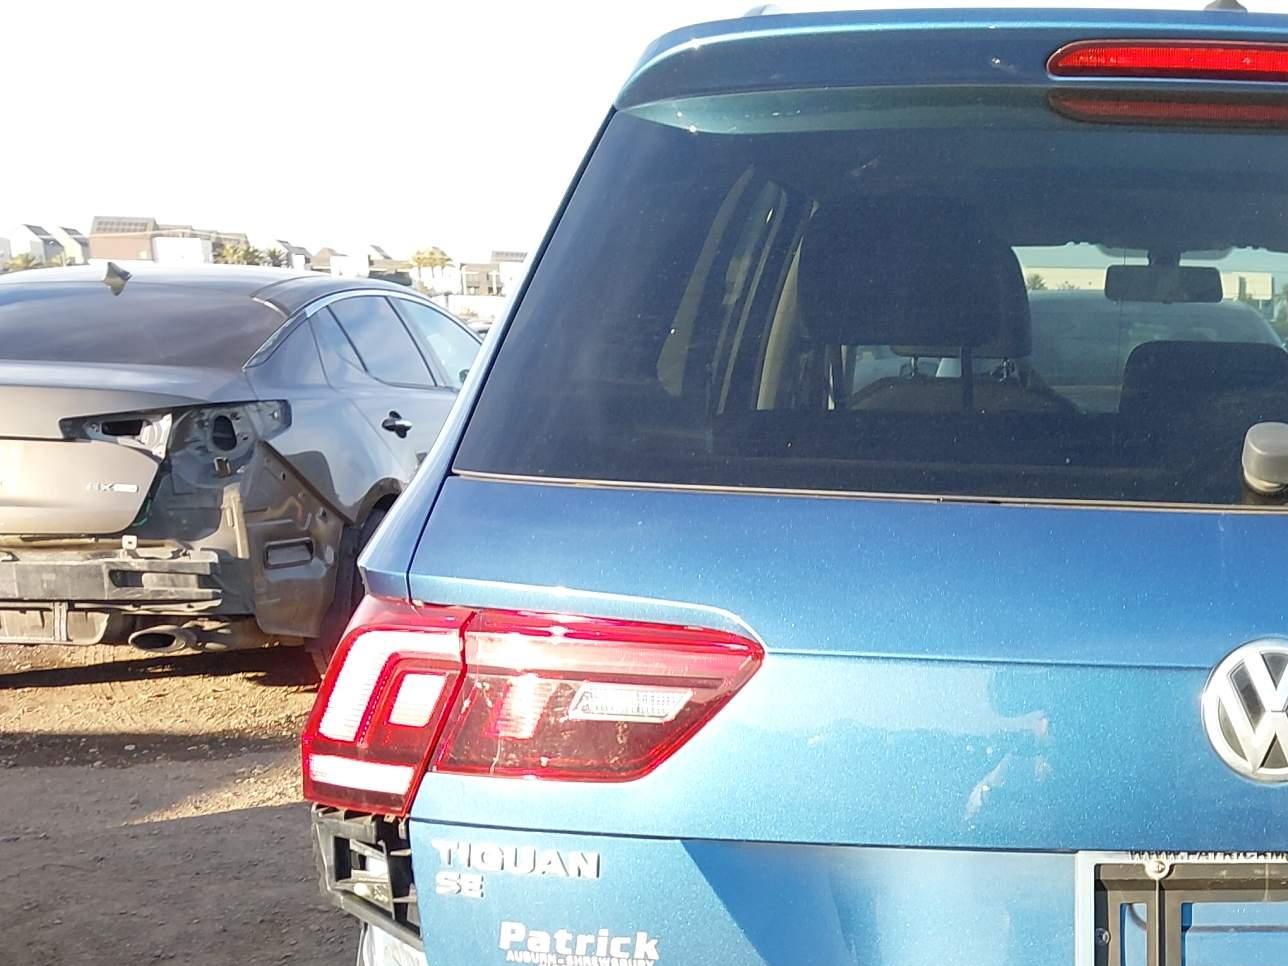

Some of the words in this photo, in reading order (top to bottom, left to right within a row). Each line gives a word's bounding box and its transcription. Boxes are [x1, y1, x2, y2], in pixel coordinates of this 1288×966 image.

[432, 840, 601, 879] TIGUAN
[436, 872, 485, 899] SE
[499, 921, 659, 960] Patrick
